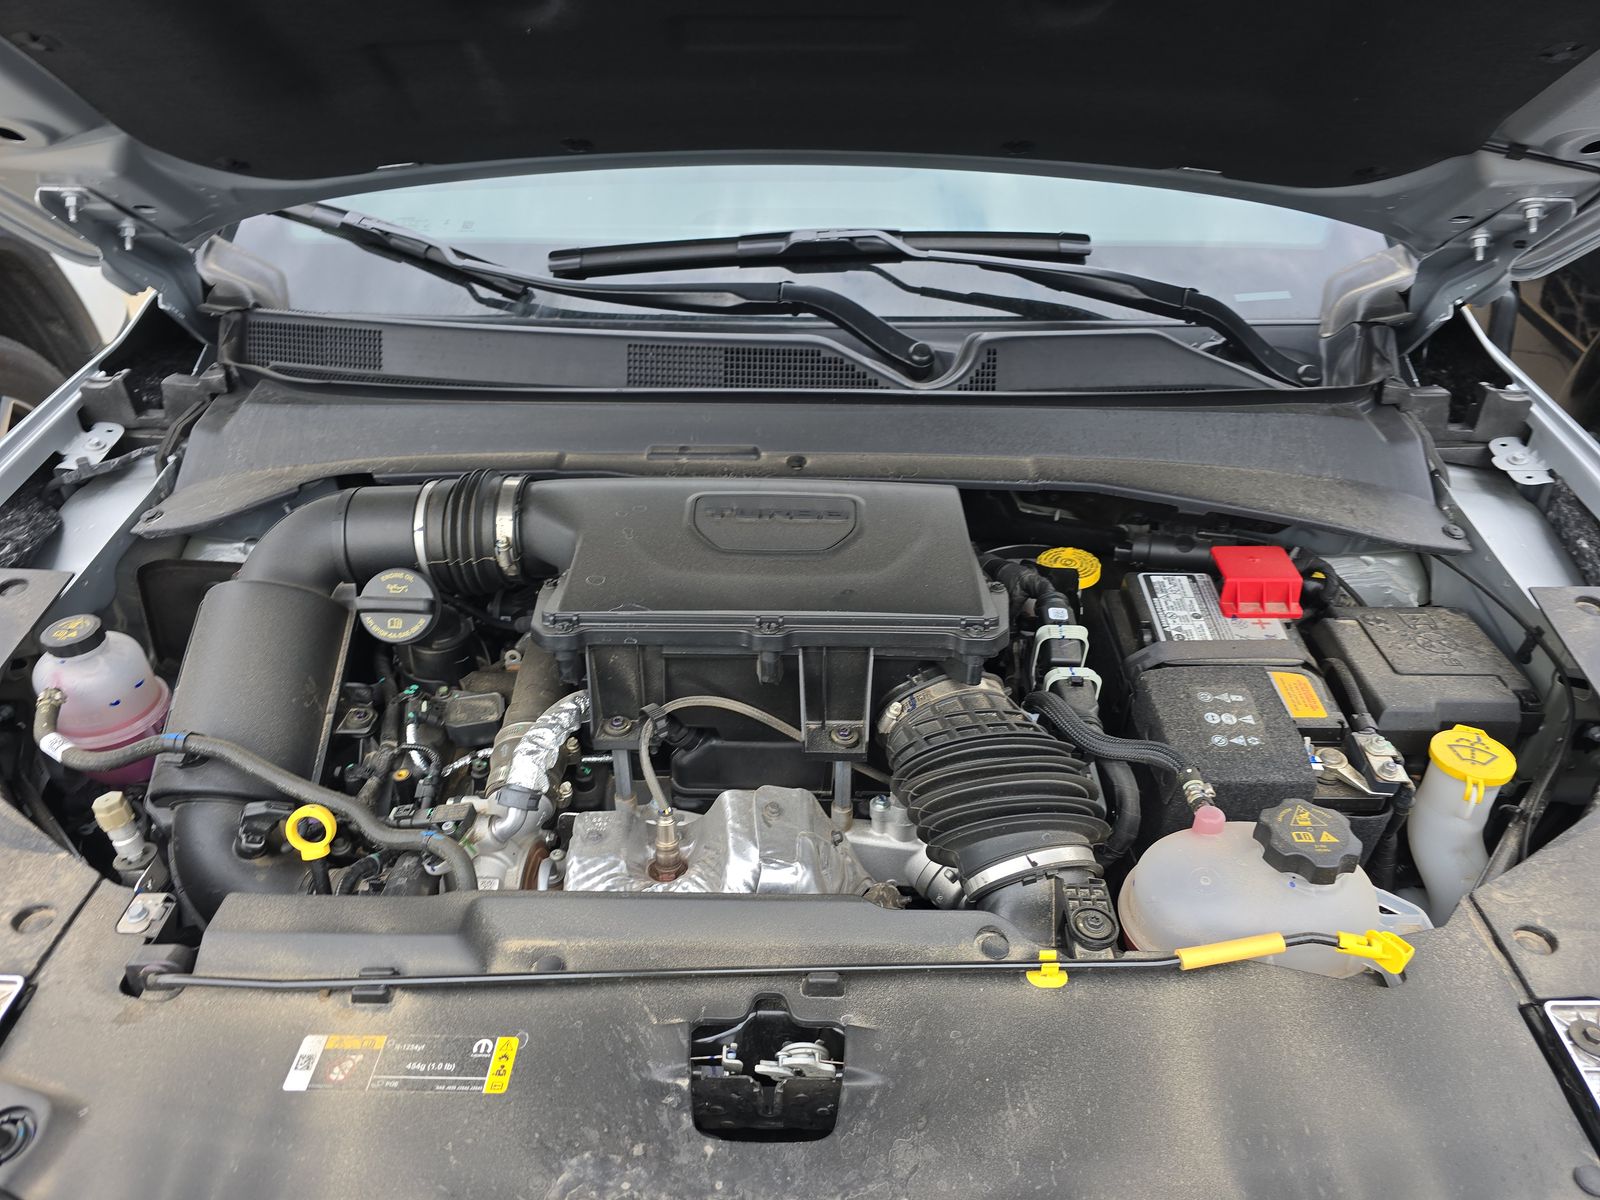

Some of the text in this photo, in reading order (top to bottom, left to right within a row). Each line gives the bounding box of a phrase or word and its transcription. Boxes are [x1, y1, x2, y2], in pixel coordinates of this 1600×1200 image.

[406, 1062, 456, 1072] 454g (1.0 lb)
